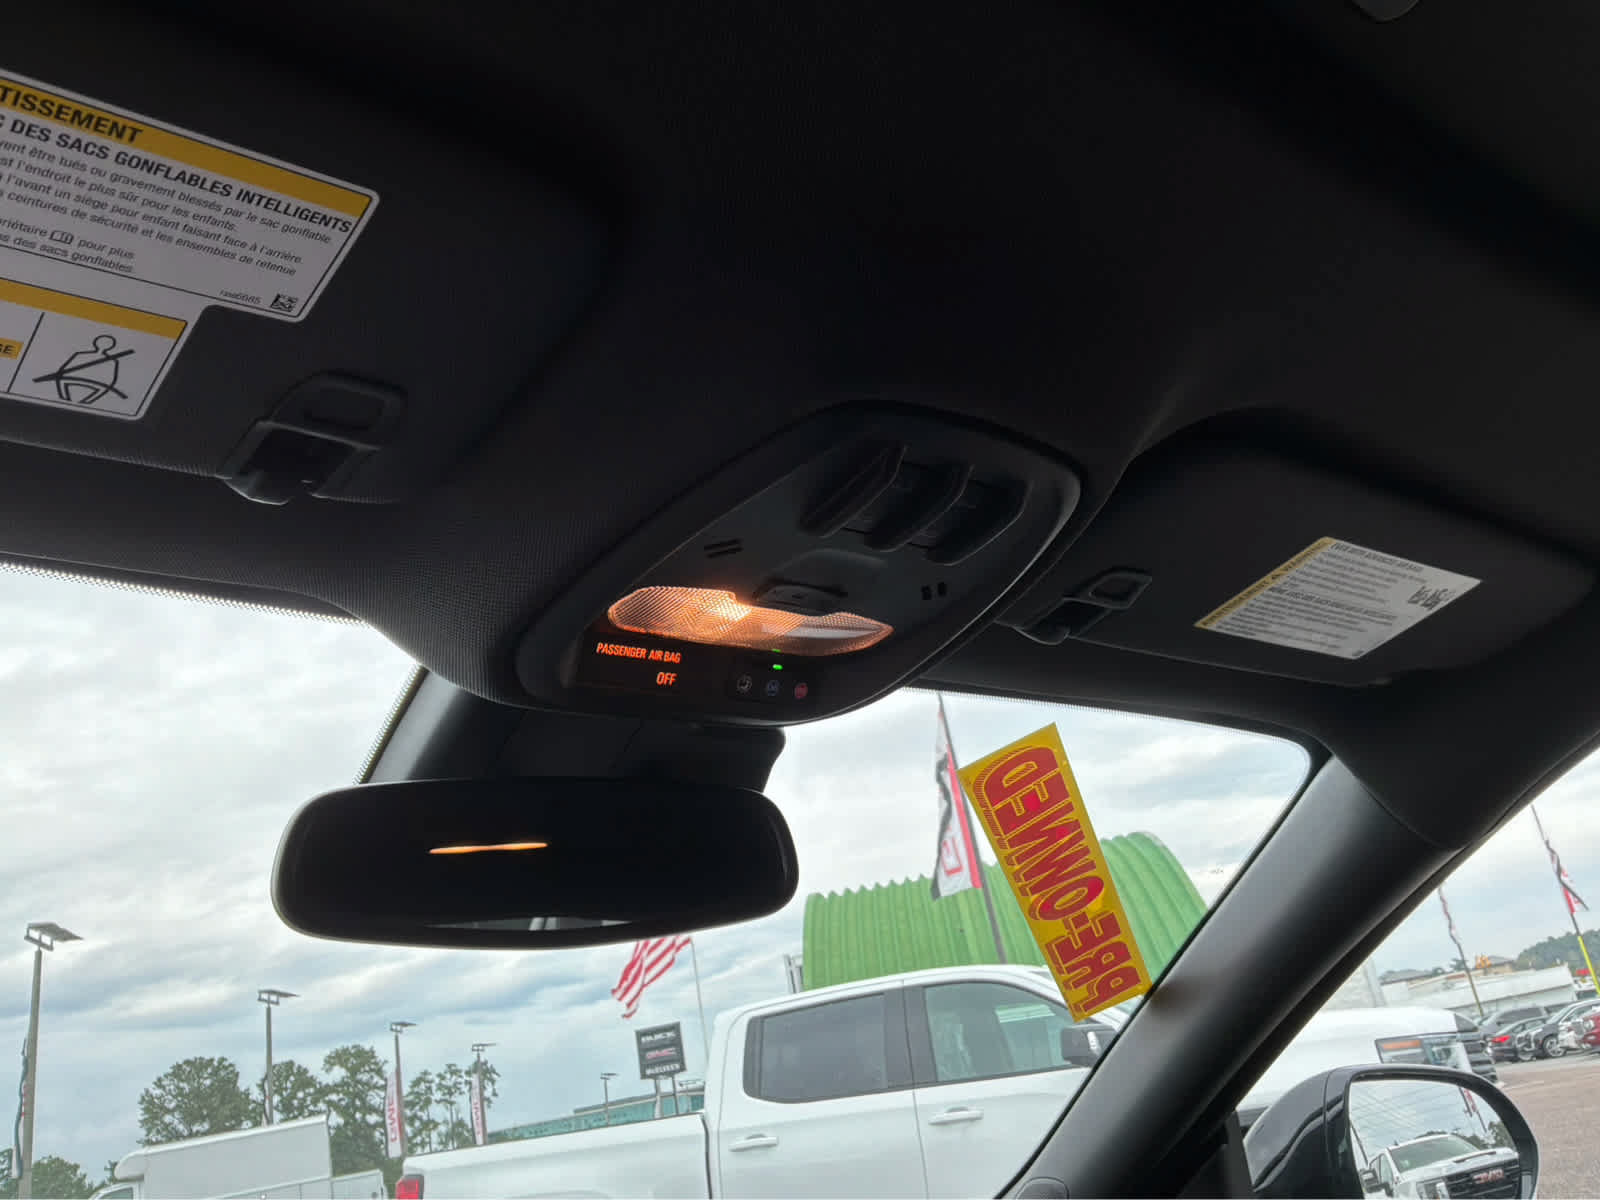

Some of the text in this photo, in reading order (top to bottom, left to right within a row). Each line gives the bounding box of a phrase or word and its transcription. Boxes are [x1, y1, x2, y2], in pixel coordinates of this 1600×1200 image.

[10, 119, 51, 142] DES
[56, 133, 111, 160] SACS
[115, 151, 233, 197] GONFLABLES
[236, 188, 353, 233] INTELLIGENTS
[16, 159, 72, 184] l'endroit
[74, 175, 87, 187] le
[88, 182, 117, 197] plus
[119, 189, 140, 203] sûr
[140, 198, 170, 213] pour
[172, 205, 189, 218] les
[28, 146, 56, 163] être
[58, 155, 87, 172] tués
[90, 166, 107, 177] ou
[110, 172, 177, 198] gravement
[178, 189, 222, 213] blessés
[223, 206, 247, 220] par
[246, 210, 258, 223] le
[260, 217, 280, 230] sac
[6, 173, 52, 194] l'avant
[54, 189, 71, 200] un
[73, 192, 109, 210] siège
[110, 204, 140, 218] pour
[141, 212, 180, 231] enfant
[182, 221, 222, 242] faisant
[223, 234, 248, 249] face
[249, 240, 258, 252] à
[7, 191, 68, 214] ceintures
[71, 205, 88, 220] de
[90, 213, 139, 234] sécurité
[141, 227, 155, 239] et
[156, 230, 174, 244] les
[175, 238, 236, 260] ensembles
[239, 252, 254, 265] de
[256, 258, 297, 277] retenue
[13, 236, 37, 249] des
[40, 244, 69, 258] sacs
[77, 238, 109, 253] pour
[108, 245, 135, 260] plus
[596, 642, 682, 664] PASSENGER AIR BAG
[656, 671, 678, 686] OFF
